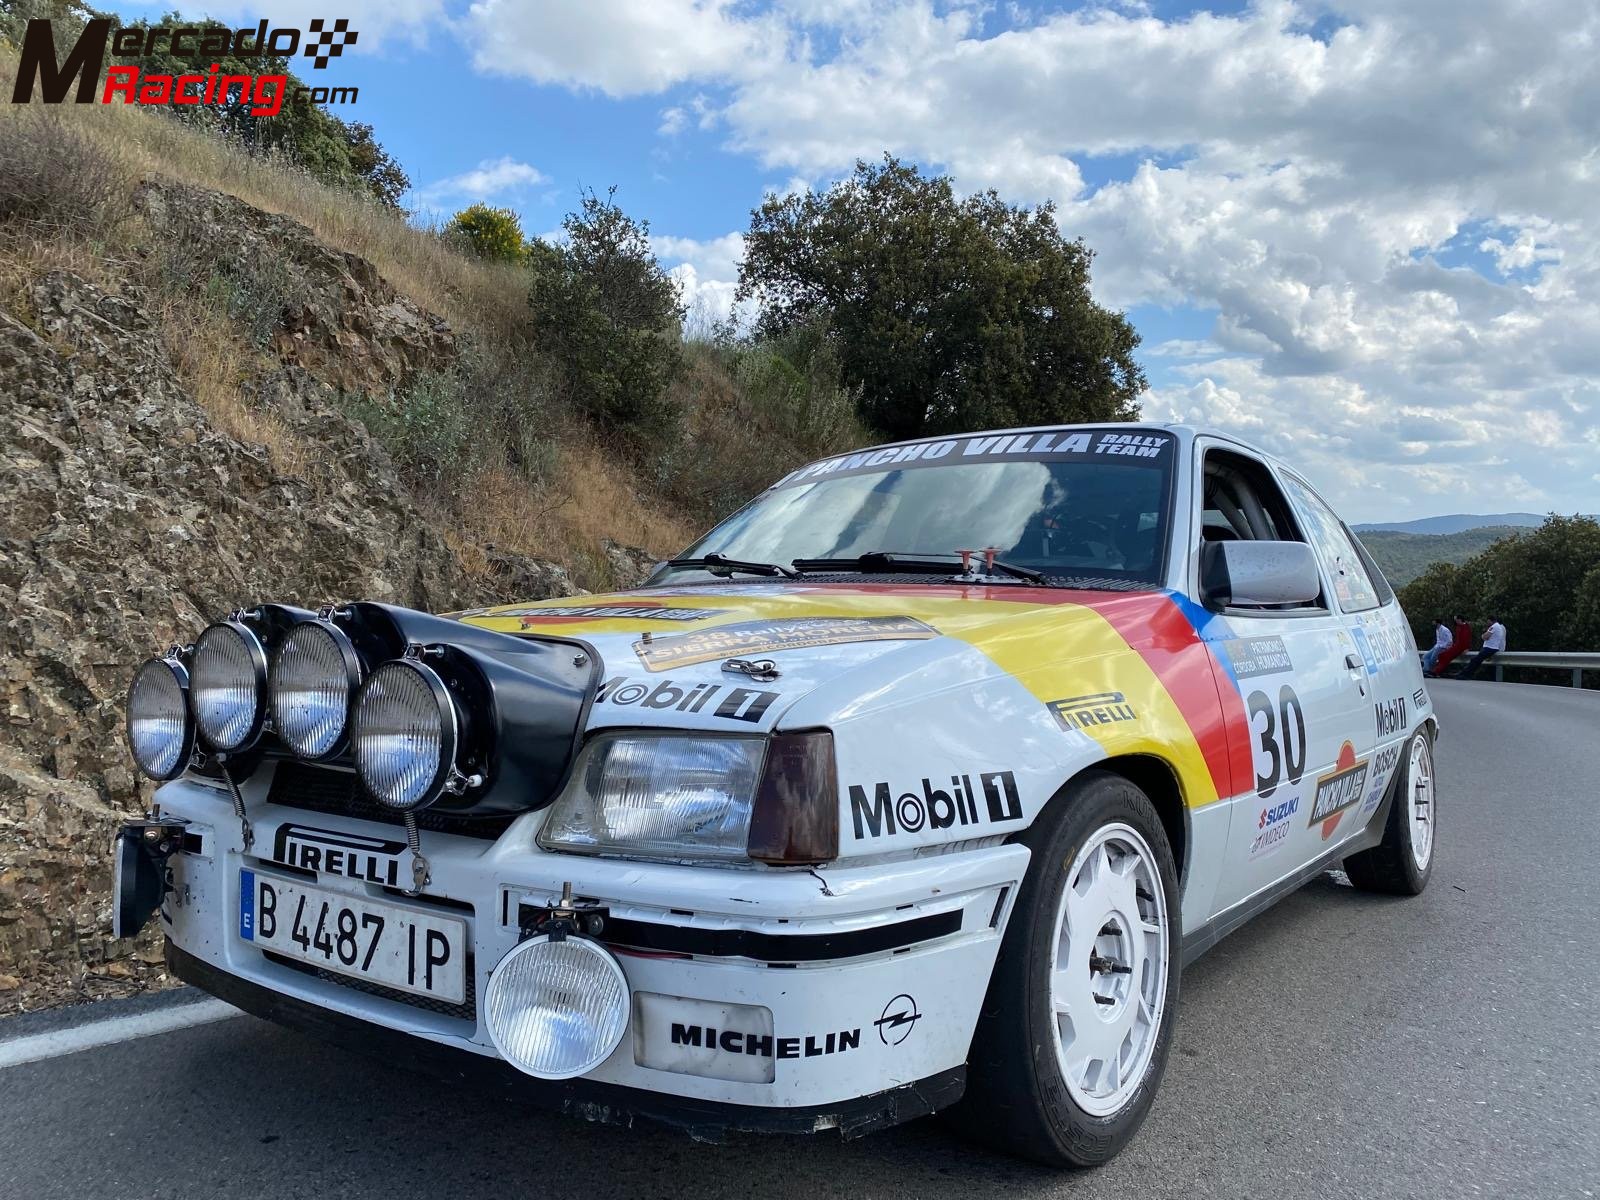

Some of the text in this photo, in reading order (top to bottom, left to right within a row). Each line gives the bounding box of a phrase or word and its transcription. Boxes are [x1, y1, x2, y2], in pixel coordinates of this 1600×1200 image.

[796, 432, 1093, 482] PANCHO VILLA
[1094, 443, 1162, 459] TEAM
[1100, 433, 1169, 448] RALLY
[652, 636, 772, 659] SIERRA
[777, 623, 921, 641] MORENA
[594, 676, 722, 714] Mobil
[1045, 691, 1137, 732] PIRELLI
[1374, 700, 1400, 739] Mobil
[1246, 684, 1307, 799] 30
[1372, 745, 1399, 778] BOSCH
[848, 774, 980, 841] Mobil
[1265, 796, 1300, 827] SUZUKI
[272, 822, 408, 887] PIRELLI
[243, 912, 252, 929] E
[258, 881, 451, 991] B 4487 IP
[670, 1022, 861, 1060] MICHELIN
